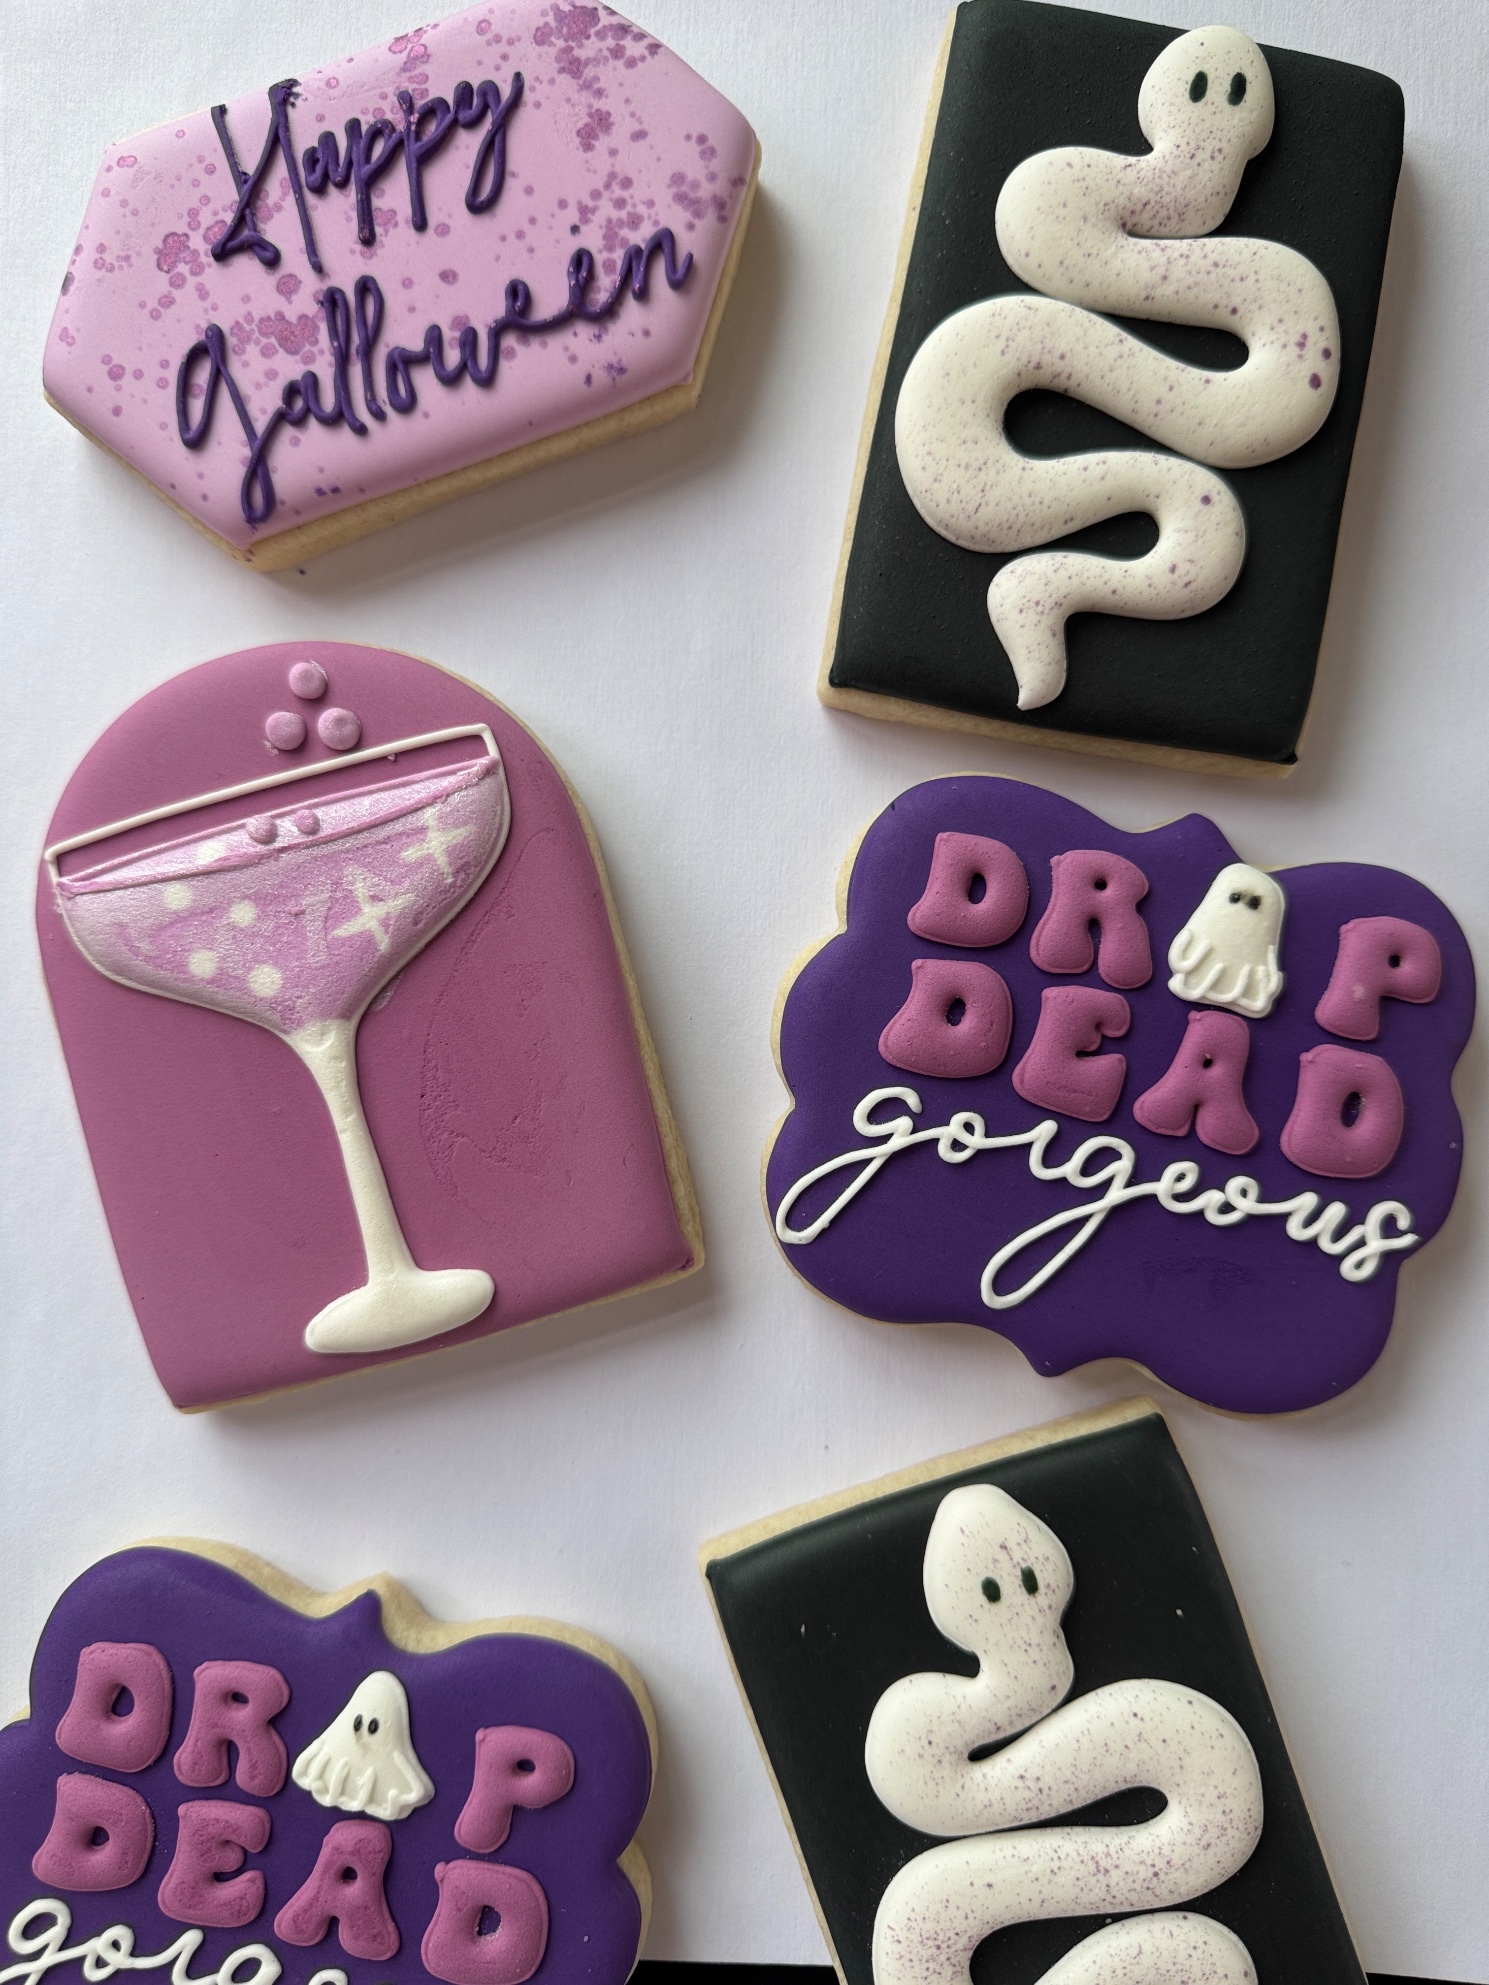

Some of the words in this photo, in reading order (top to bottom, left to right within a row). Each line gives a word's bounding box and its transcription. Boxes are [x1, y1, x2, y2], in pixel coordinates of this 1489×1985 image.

[211, 72, 524, 273] Happy
[176, 228, 694, 525] Halloween
[907, 832, 1442, 1040] DRP
[879, 959, 1405, 1178] DEAD
[776, 1086, 1419, 1309] gorgeous
[55, 1642, 576, 1853] DRP
[32, 1772, 549, 1985] DEAD
